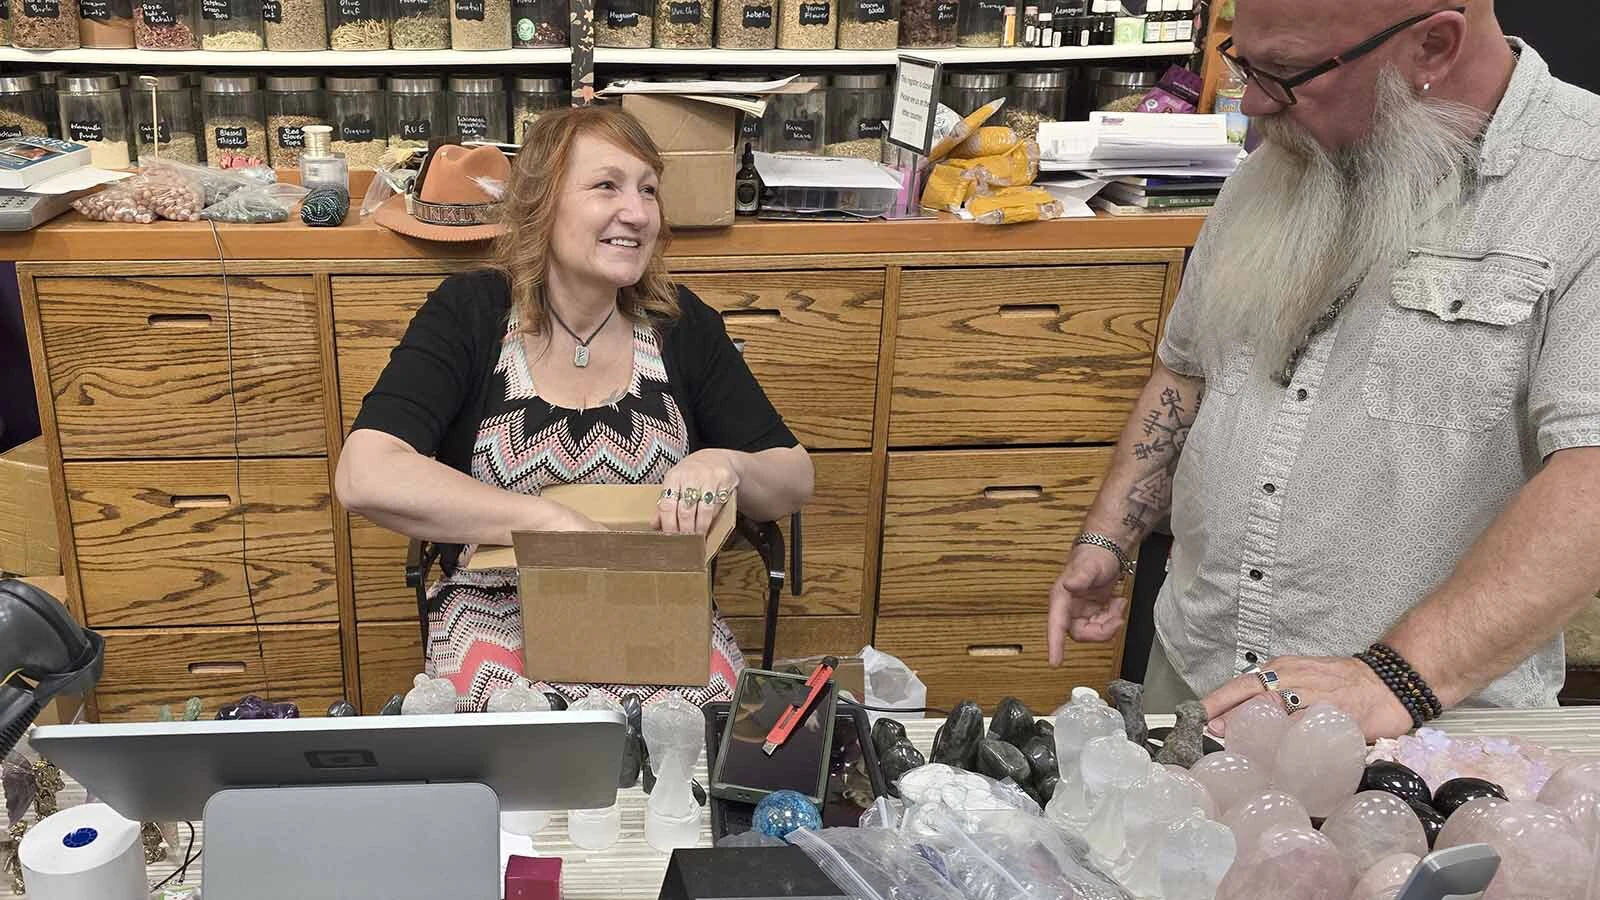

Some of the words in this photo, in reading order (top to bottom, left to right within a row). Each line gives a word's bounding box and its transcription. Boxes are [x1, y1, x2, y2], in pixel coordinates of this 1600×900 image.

[938, 4, 951, 12] Star
[609, 11, 638, 22] Mugwort
[745, 10, 770, 18] Lobelia
[404, 123, 425, 135] RUE
[785, 123, 803, 131] Kava
[219, 128, 243, 137] Blessed
[218, 136, 247, 145] Thistle
